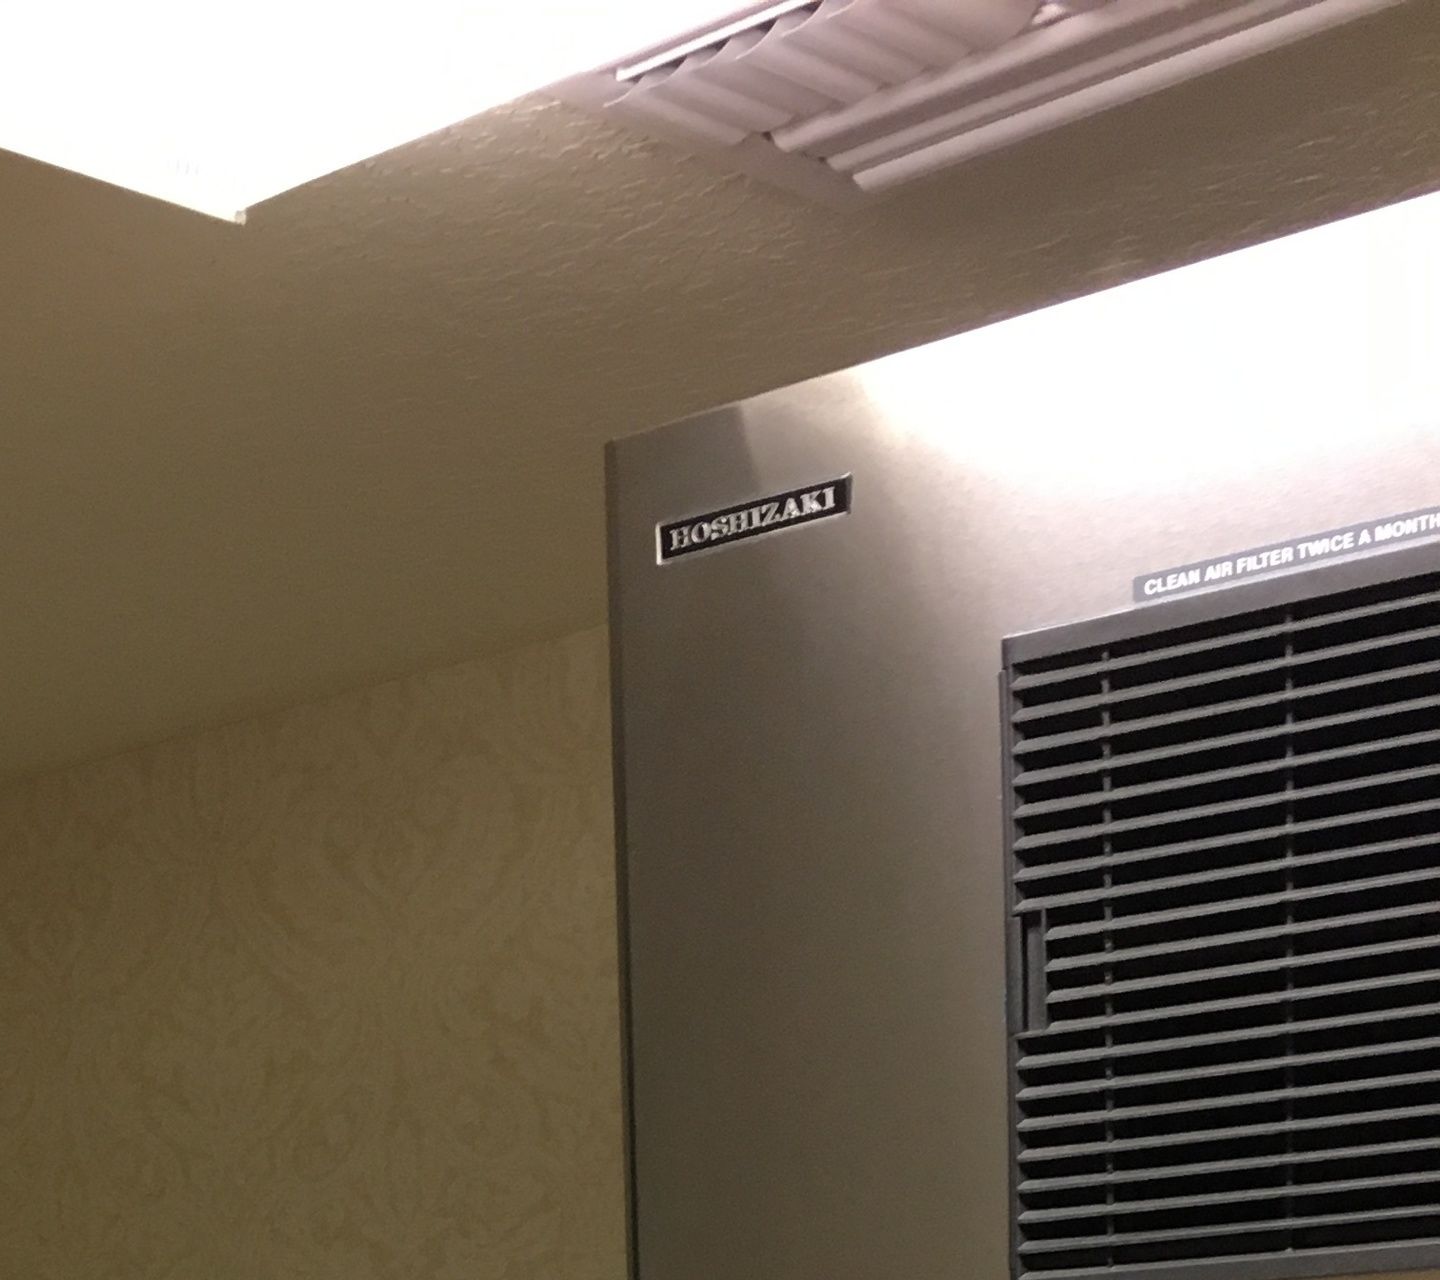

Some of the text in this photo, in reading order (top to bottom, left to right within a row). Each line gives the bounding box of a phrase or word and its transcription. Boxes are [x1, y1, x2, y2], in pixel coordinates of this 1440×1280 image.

[669, 486, 836, 551] HOSHIZAKI
[1144, 512, 1440, 596] CLEAN AIR FILTER TWICE A MONTH
